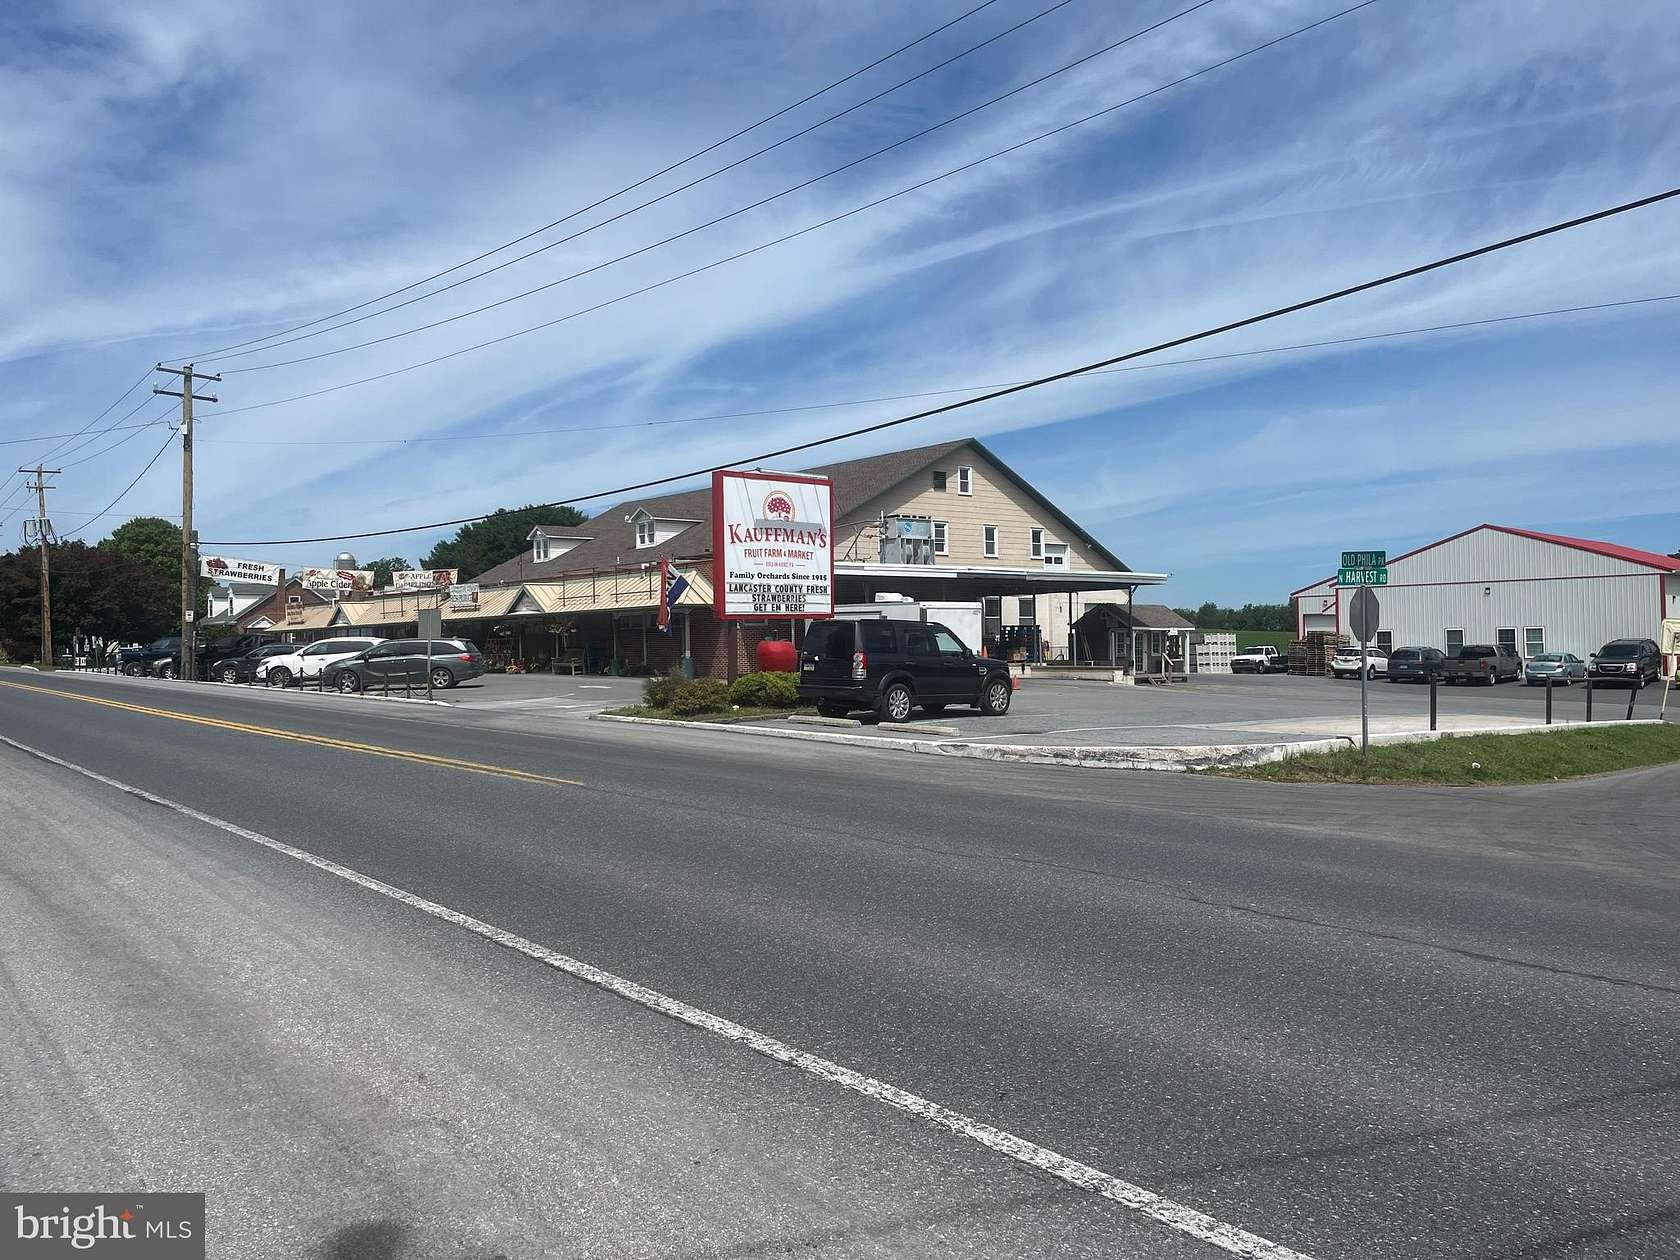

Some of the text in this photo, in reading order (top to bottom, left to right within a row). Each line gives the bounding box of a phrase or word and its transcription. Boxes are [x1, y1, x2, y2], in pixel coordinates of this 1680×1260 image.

[728, 523, 827, 549] KAUFFMAN'S
[744, 549, 763, 558] FRUIT
[764, 549, 782, 558] FARM
[787, 549, 814, 560] MARKET
[1343, 554, 1355, 566] OLD
[1357, 554, 1376, 566] PHILA
[237, 562, 265, 572] FRESH
[207, 567, 273, 582] STRAWBERRIES
[729, 571, 755, 580] Family
[757, 572, 790, 580] Orchards
[1339, 574, 1343, 583] N
[1345, 571, 1377, 583] HARVEST
[308, 579, 352, 589] Apple Cider
[729, 583, 828, 594] LANCASTER COUNTY FRESH
[752, 593, 807, 603] STRAWBERRIES
[753, 603, 805, 612] GET EM HERE!
